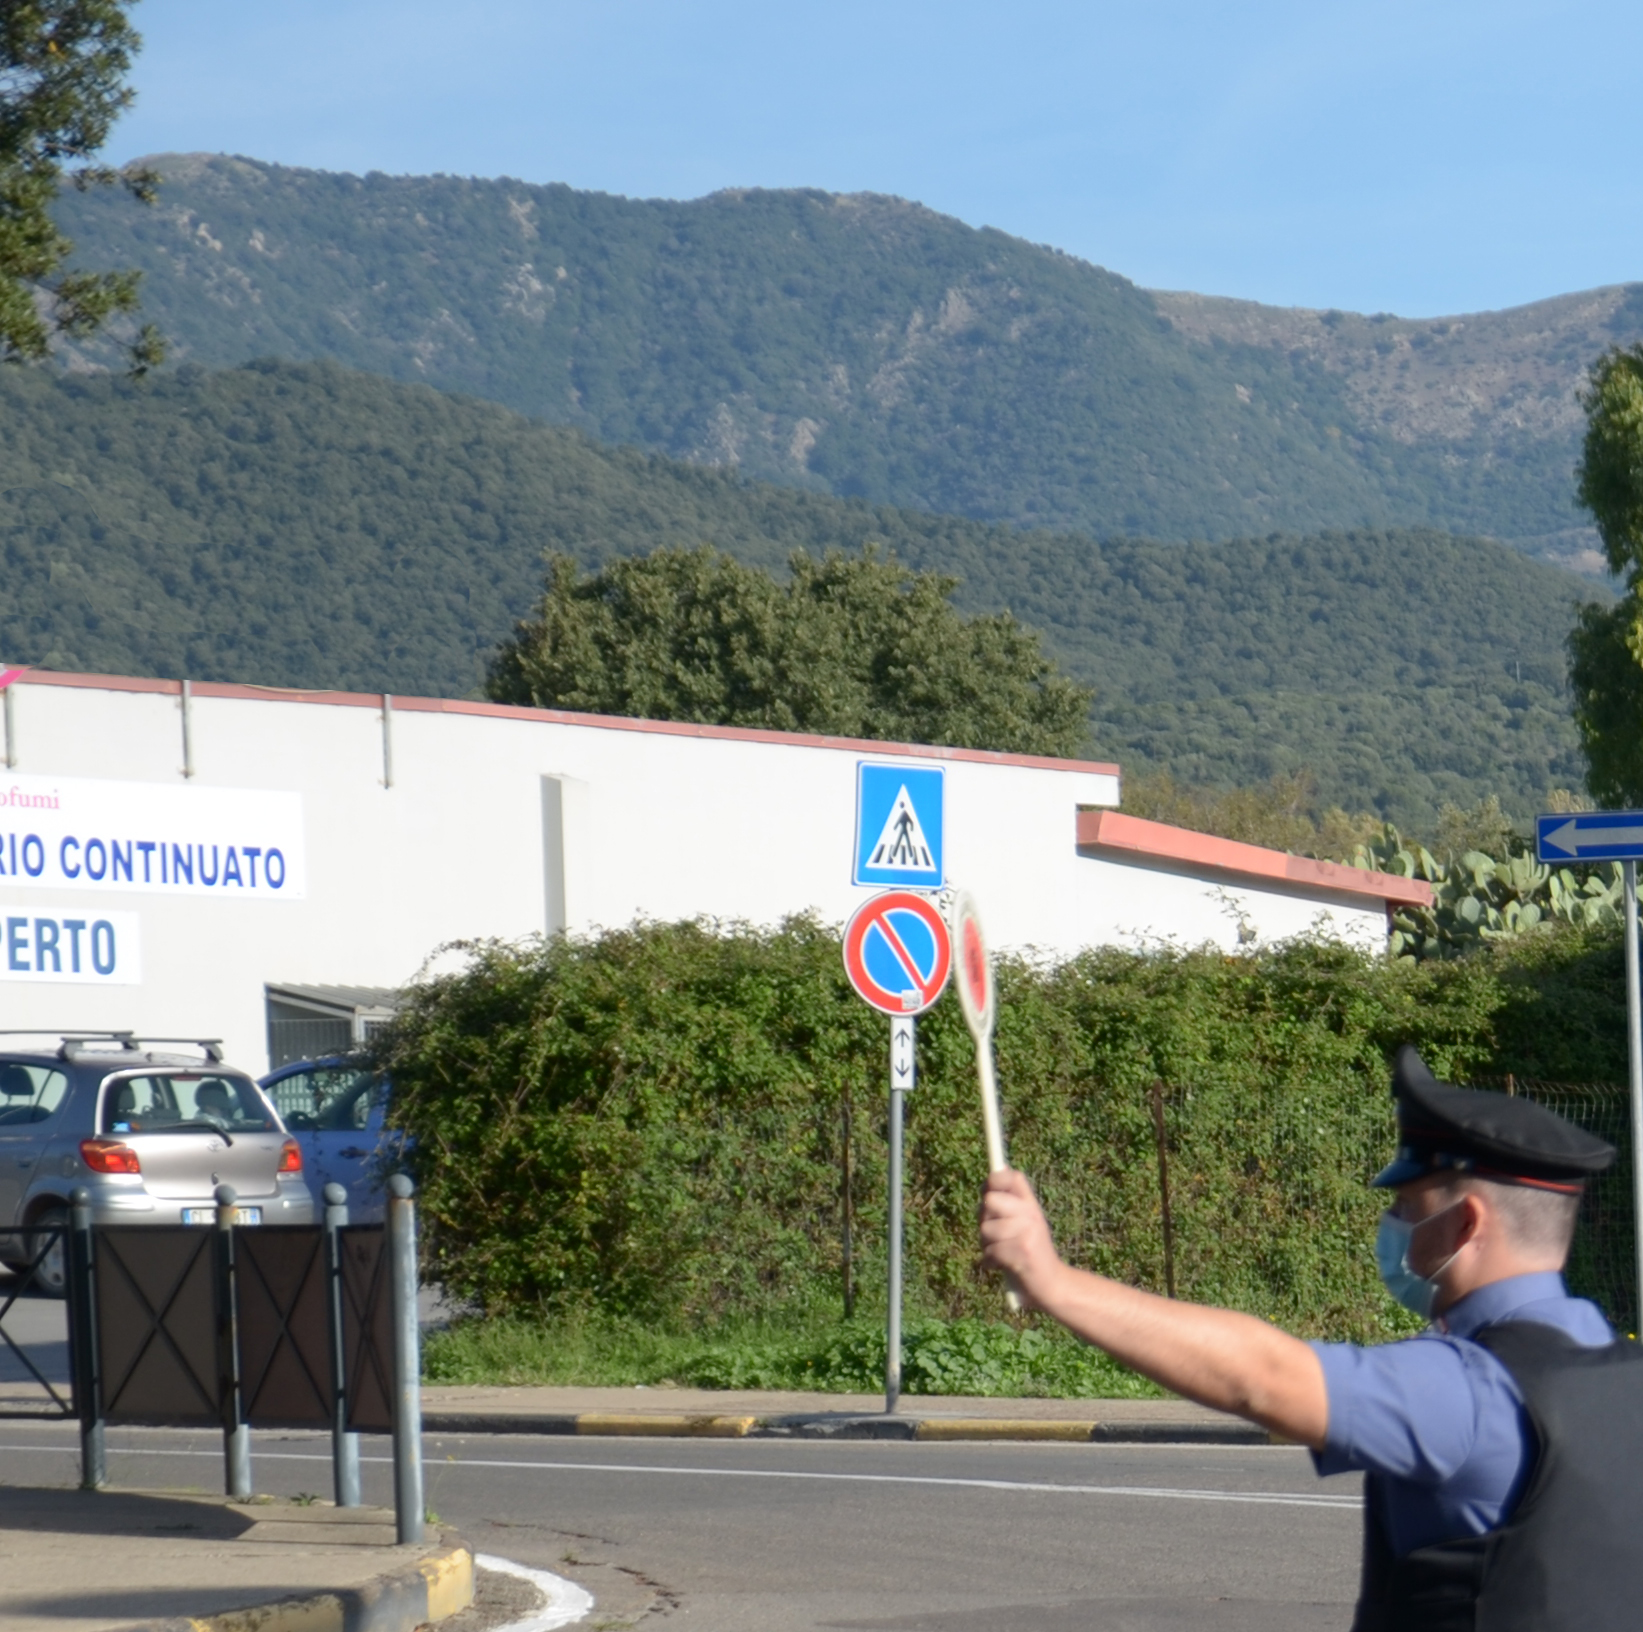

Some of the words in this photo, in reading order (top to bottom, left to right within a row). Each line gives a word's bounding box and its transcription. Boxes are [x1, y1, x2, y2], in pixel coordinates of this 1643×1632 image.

[0, 833, 45, 877] IO
[59, 835, 286, 889] CONTINUATO
[0, 916, 116, 975] ERTO
